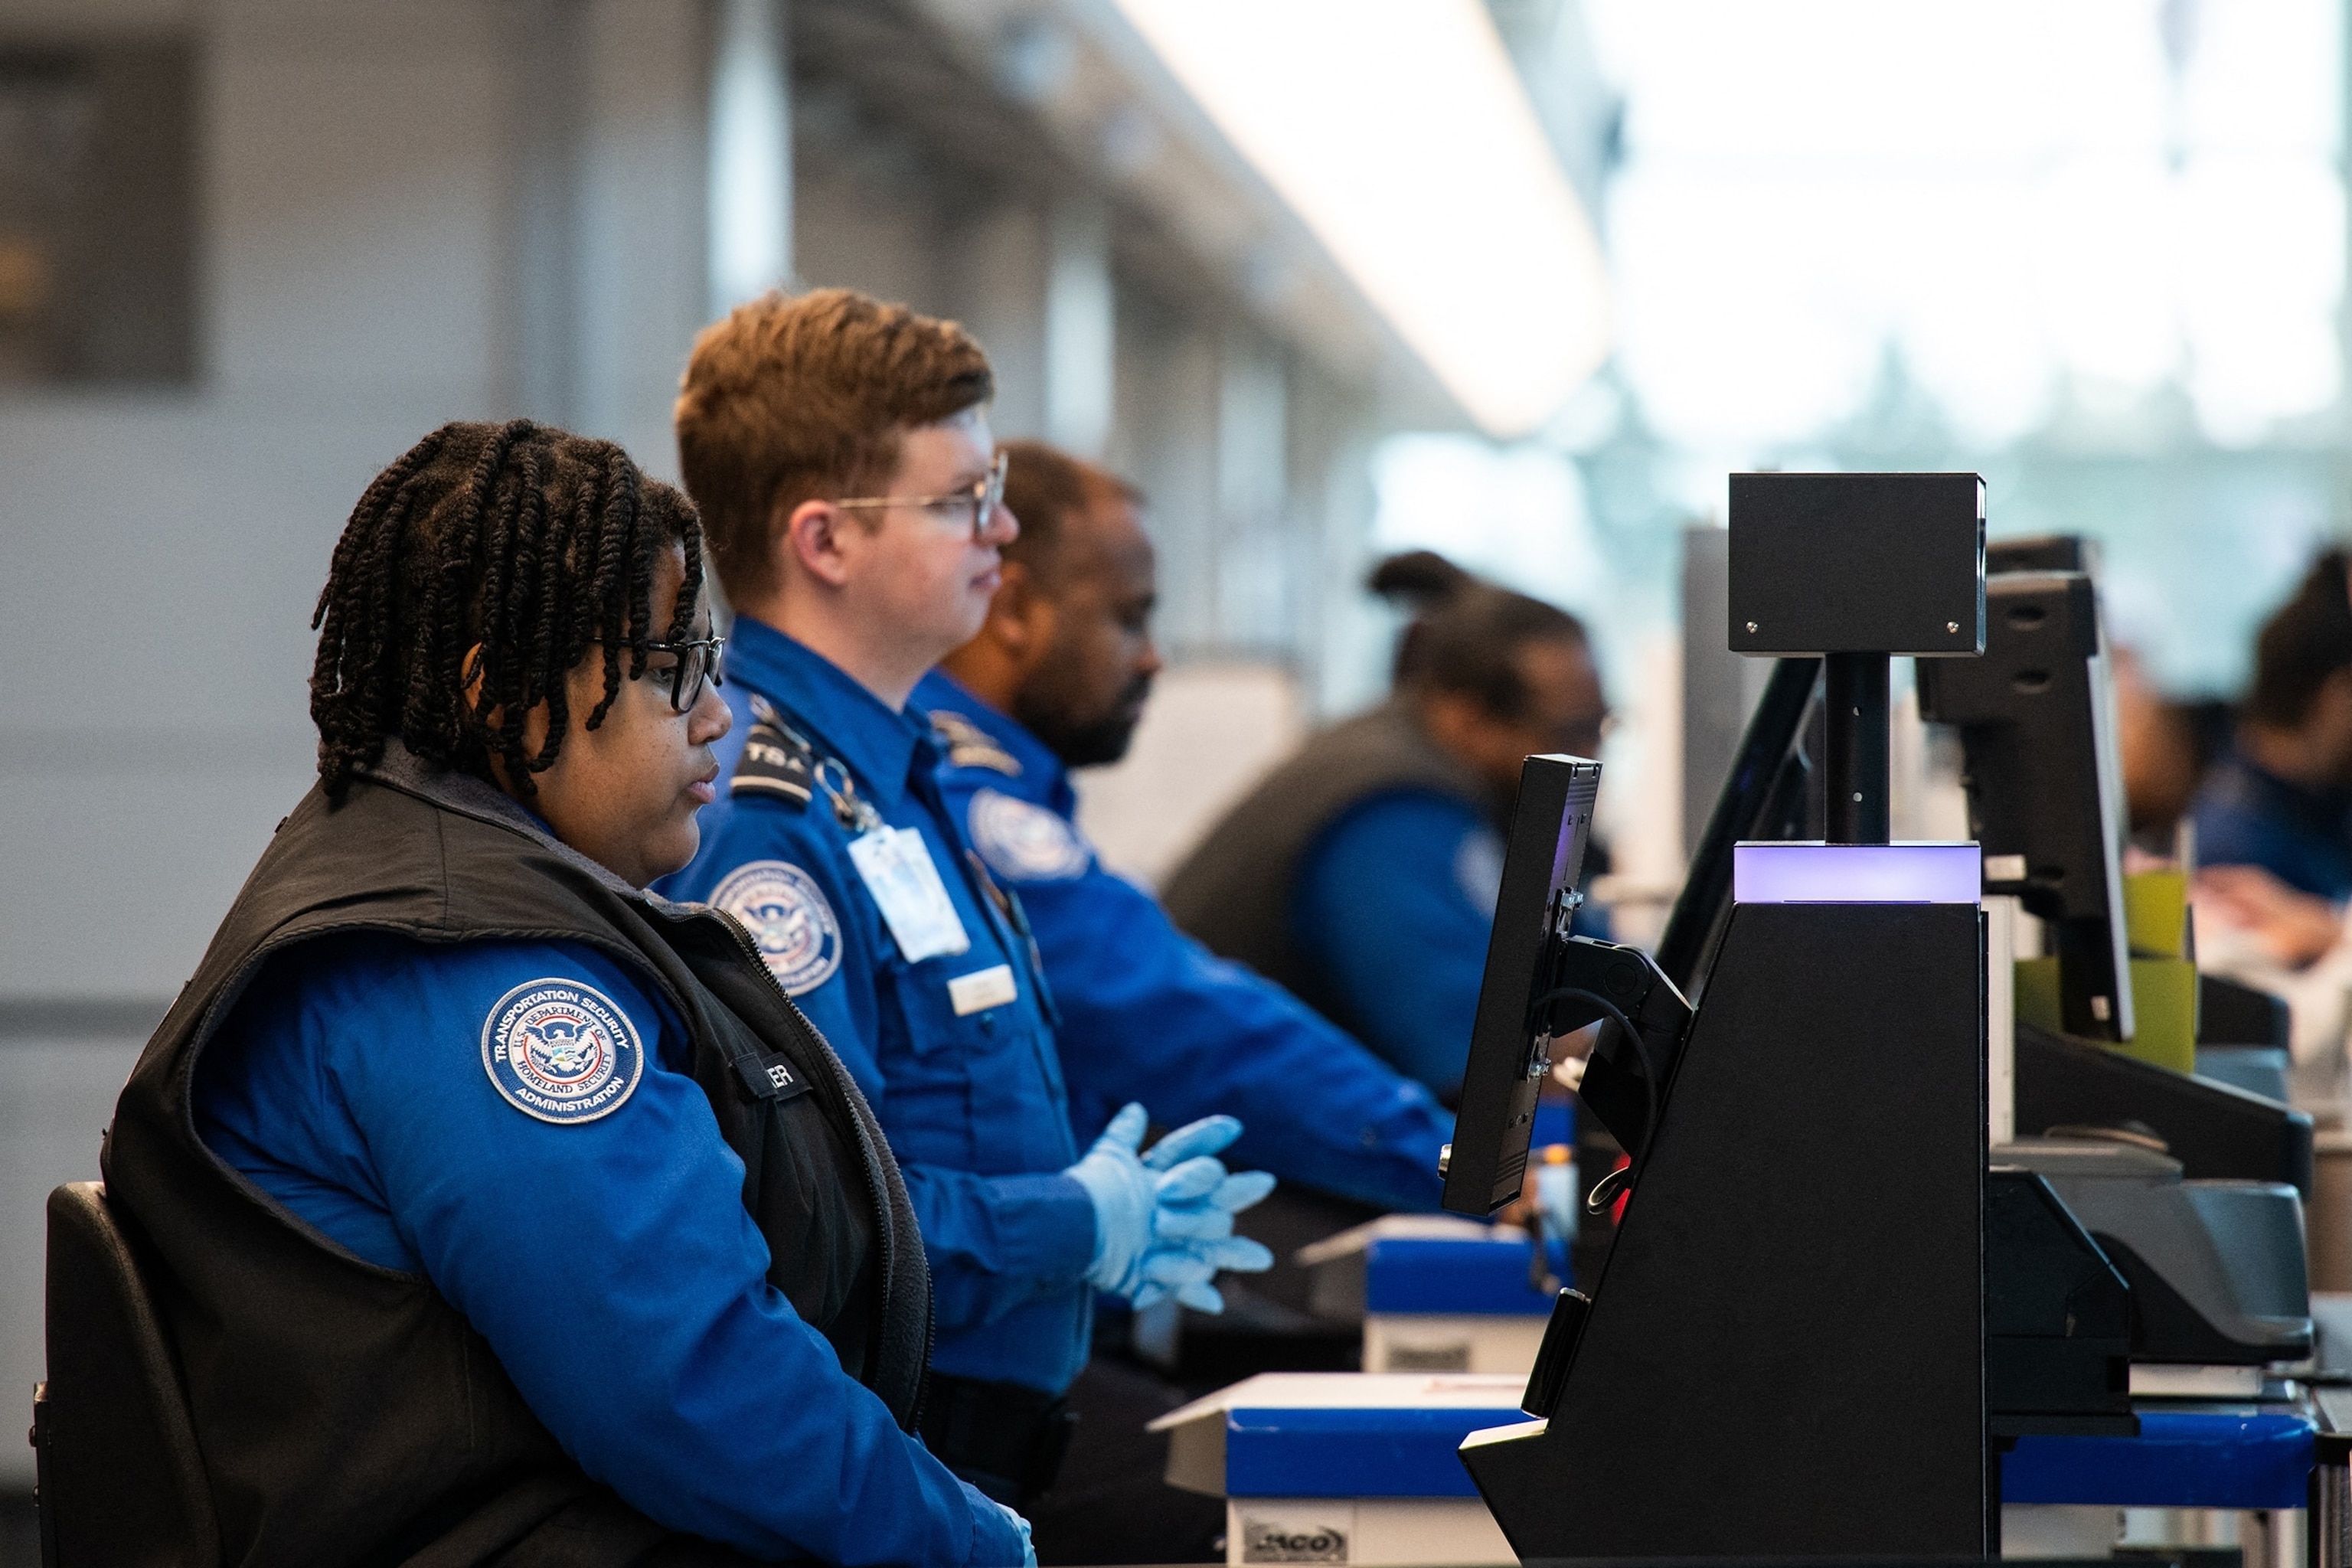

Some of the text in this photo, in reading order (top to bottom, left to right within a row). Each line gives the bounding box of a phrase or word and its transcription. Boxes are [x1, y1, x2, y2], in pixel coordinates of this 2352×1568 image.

[746, 741, 805, 774] TSA
[495, 991, 629, 1063] TRANSPORTATION SECURITY
[526, 1006, 596, 1027] DEPARTMENT
[595, 1028, 607, 1041] OF
[518, 1053, 611, 1093] HOMELAND SECURITY
[766, 1064, 793, 1089] ER
[515, 1076, 624, 1112] ADMINISTRATION
